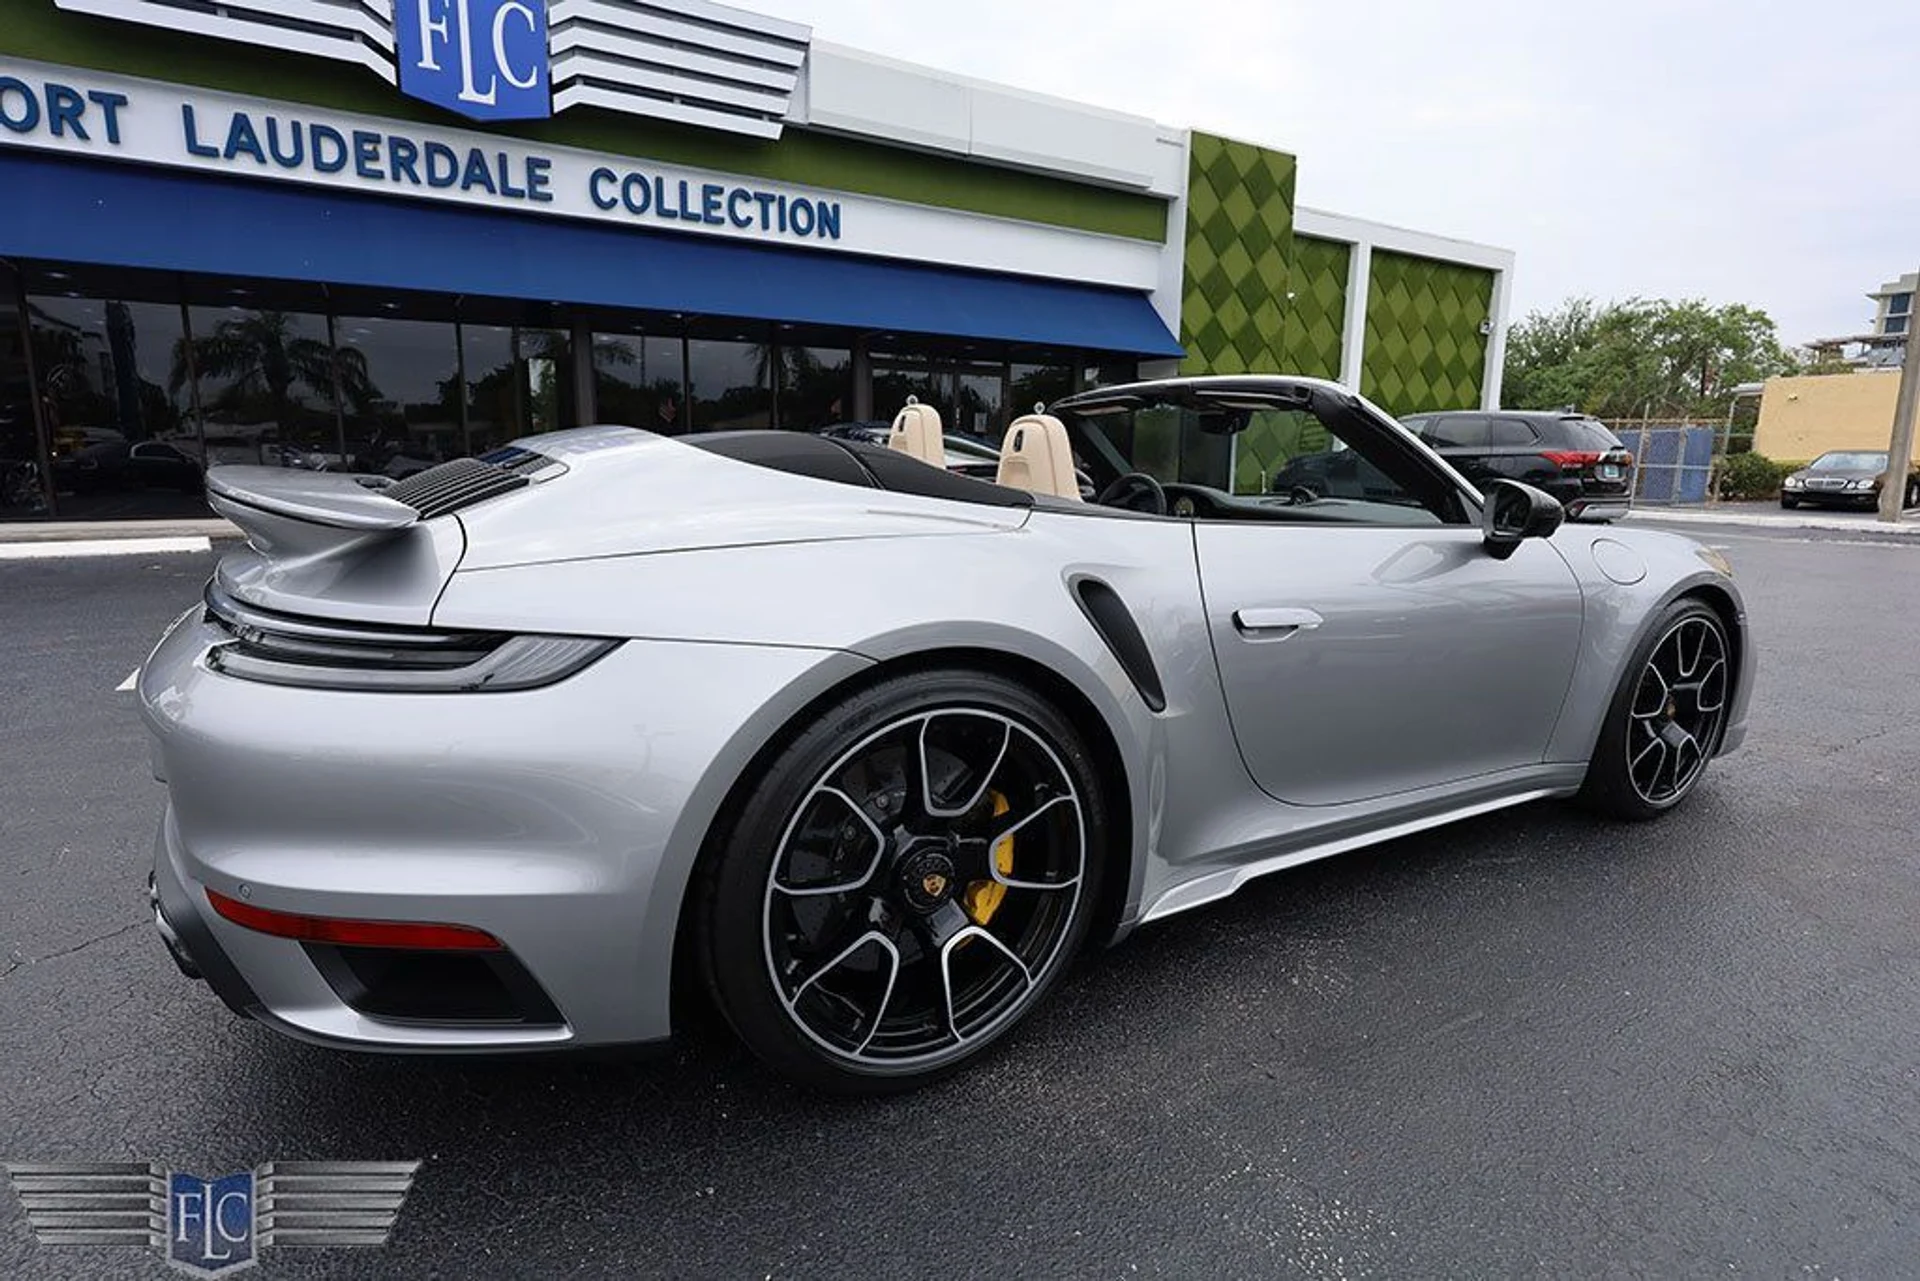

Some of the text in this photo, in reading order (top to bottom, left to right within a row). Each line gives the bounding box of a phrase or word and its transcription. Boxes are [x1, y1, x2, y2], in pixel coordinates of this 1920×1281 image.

[417, 0, 538, 106] FLC
[182, 103, 554, 202] LAUDERDALE
[589, 166, 842, 240] COLLECTION
